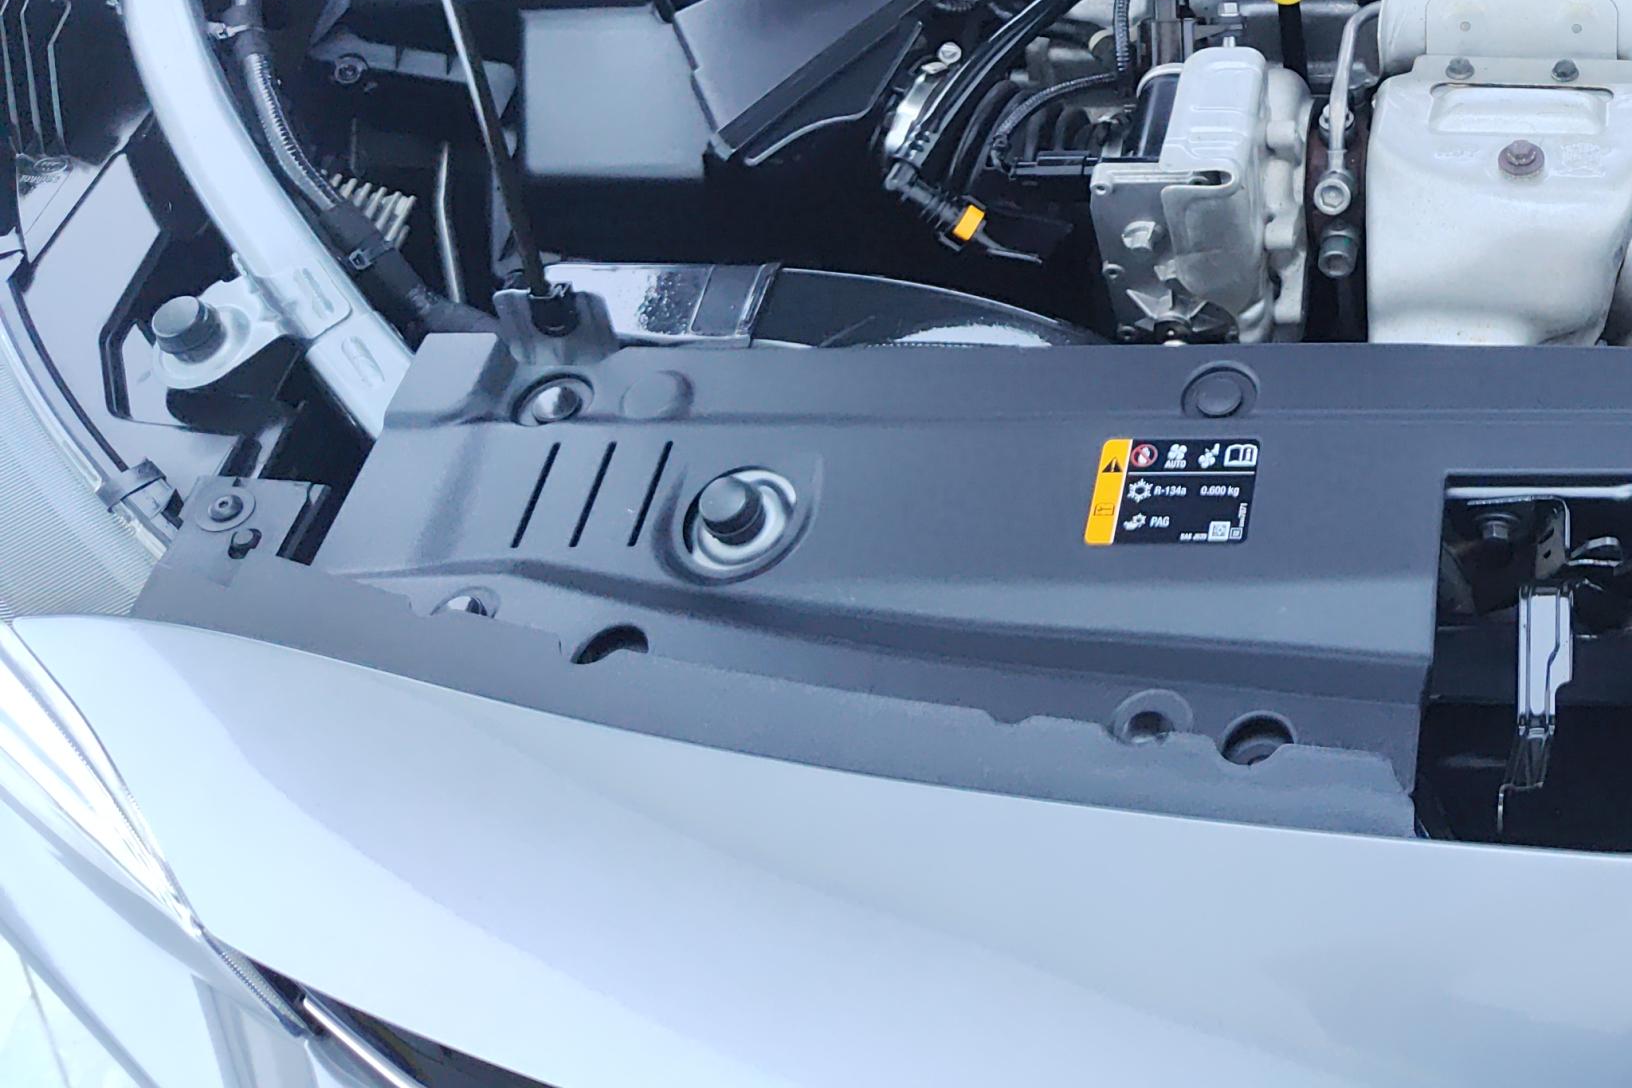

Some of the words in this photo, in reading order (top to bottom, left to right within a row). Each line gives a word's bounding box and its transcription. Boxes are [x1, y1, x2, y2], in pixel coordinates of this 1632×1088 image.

[1164, 459, 1187, 469] AUTO
[1153, 485, 1187, 496] R-134a
[1200, 485, 1226, 496] 0.600
[1227, 485, 1240, 498] kg
[1149, 516, 1170, 528] PAG
